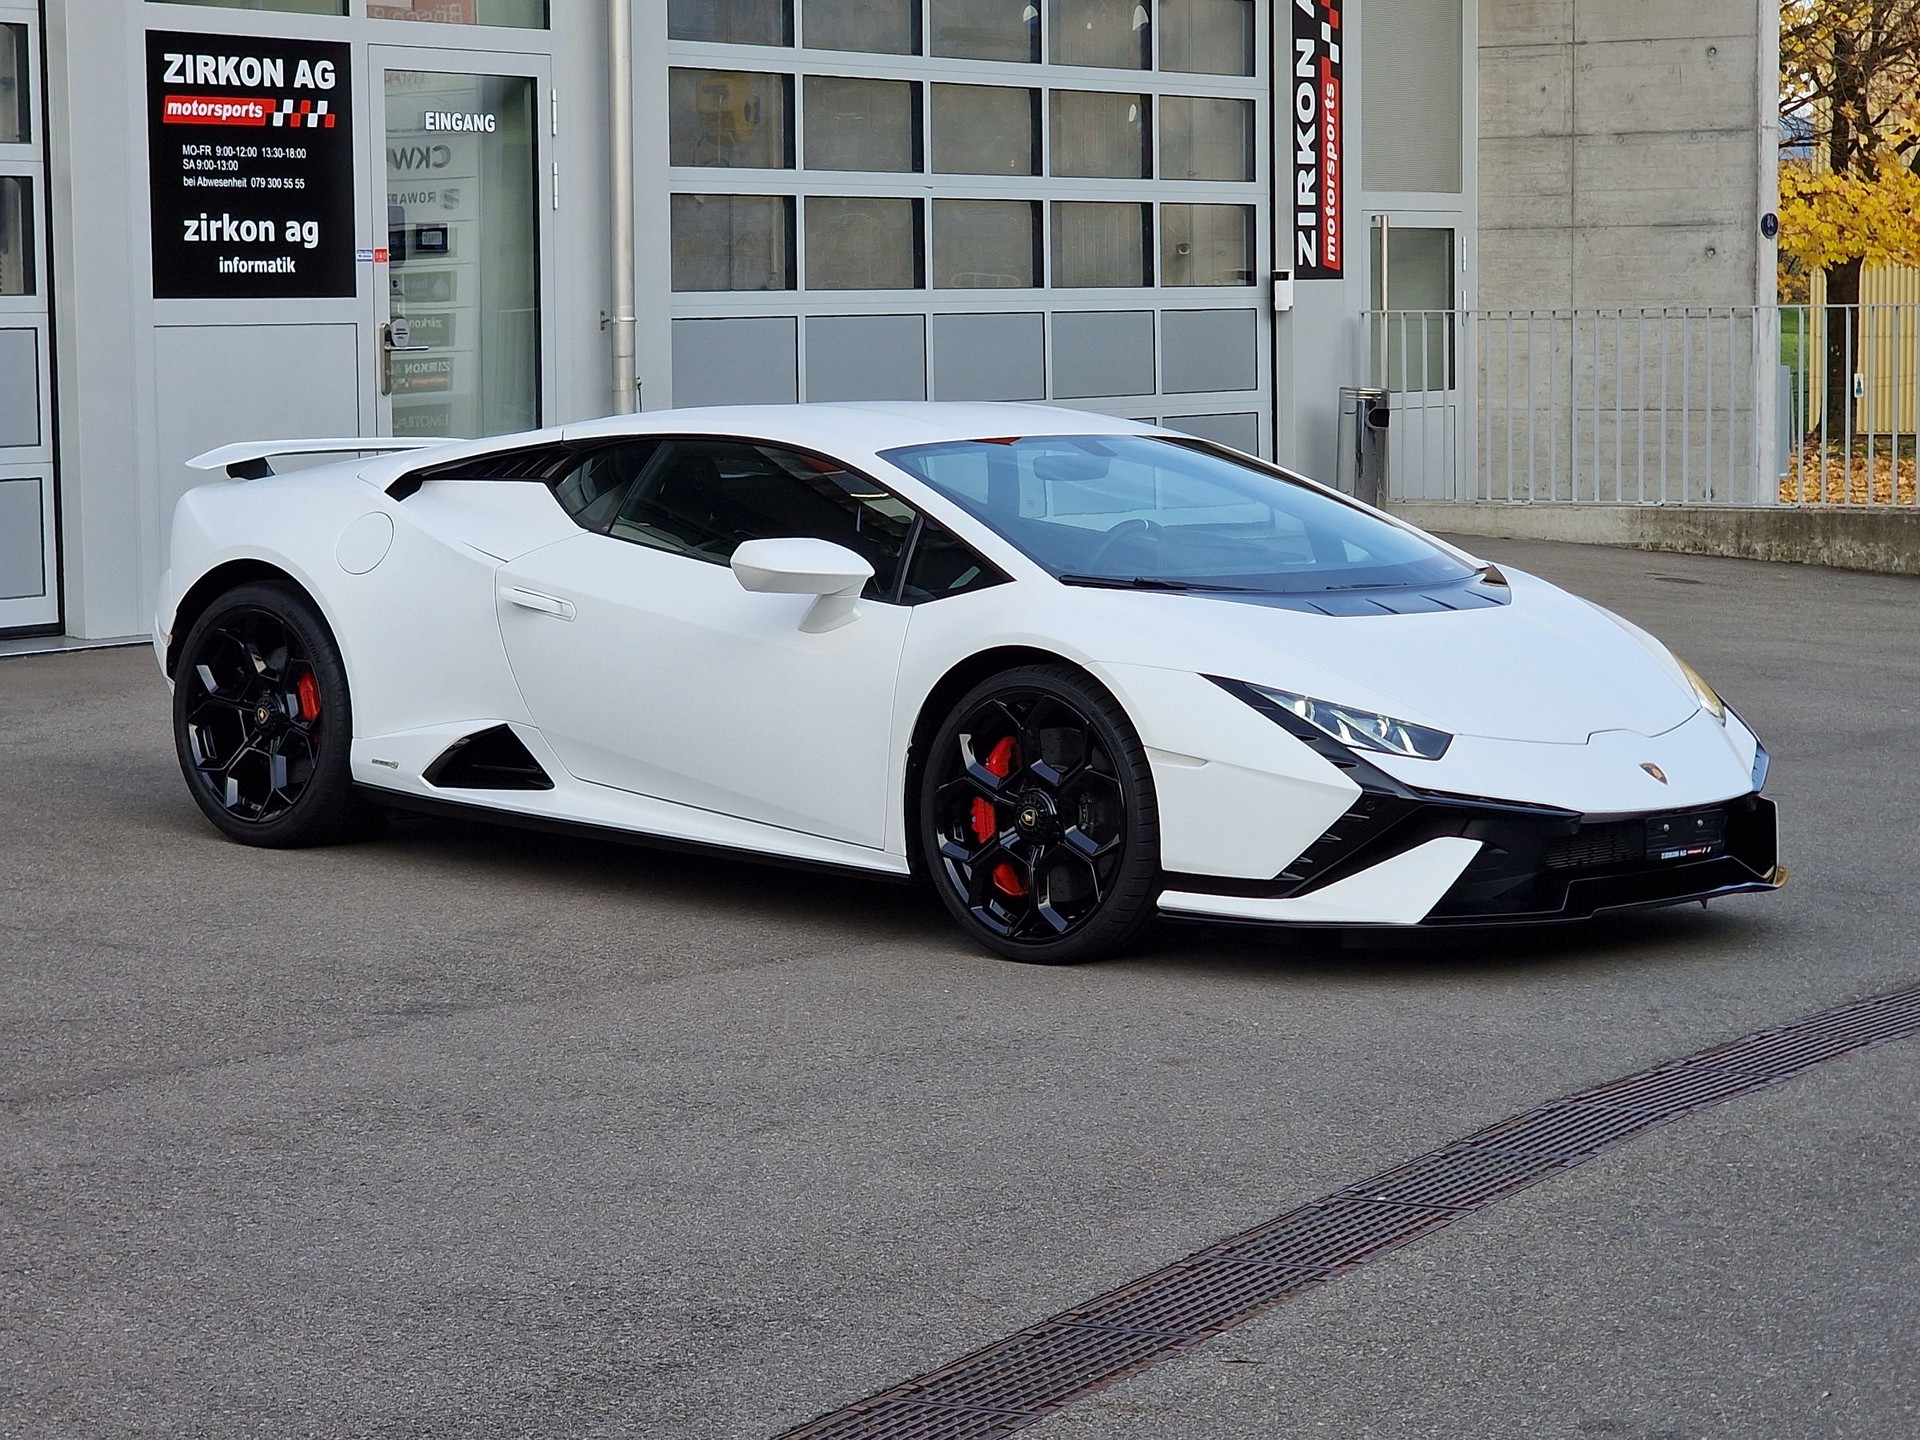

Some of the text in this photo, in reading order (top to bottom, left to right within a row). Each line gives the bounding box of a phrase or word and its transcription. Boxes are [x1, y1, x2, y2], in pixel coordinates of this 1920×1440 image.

[163, 53, 336, 90] ZIRKON AG
[167, 99, 263, 120] motorsports
[425, 111, 496, 133] EINGANG
[182, 144, 307, 159] MO-FR 9:00-12:00 13:30-18:00
[1296, 38, 1317, 268] ZIRKON
[182, 158, 239, 171] SA 9:00-13:00
[1324, 82, 1337, 262] motorsports
[183, 175, 305, 189] bei Abwesenheit 079 300 55 55
[183, 213, 319, 249] zirkon ag
[219, 256, 296, 274] informatik
